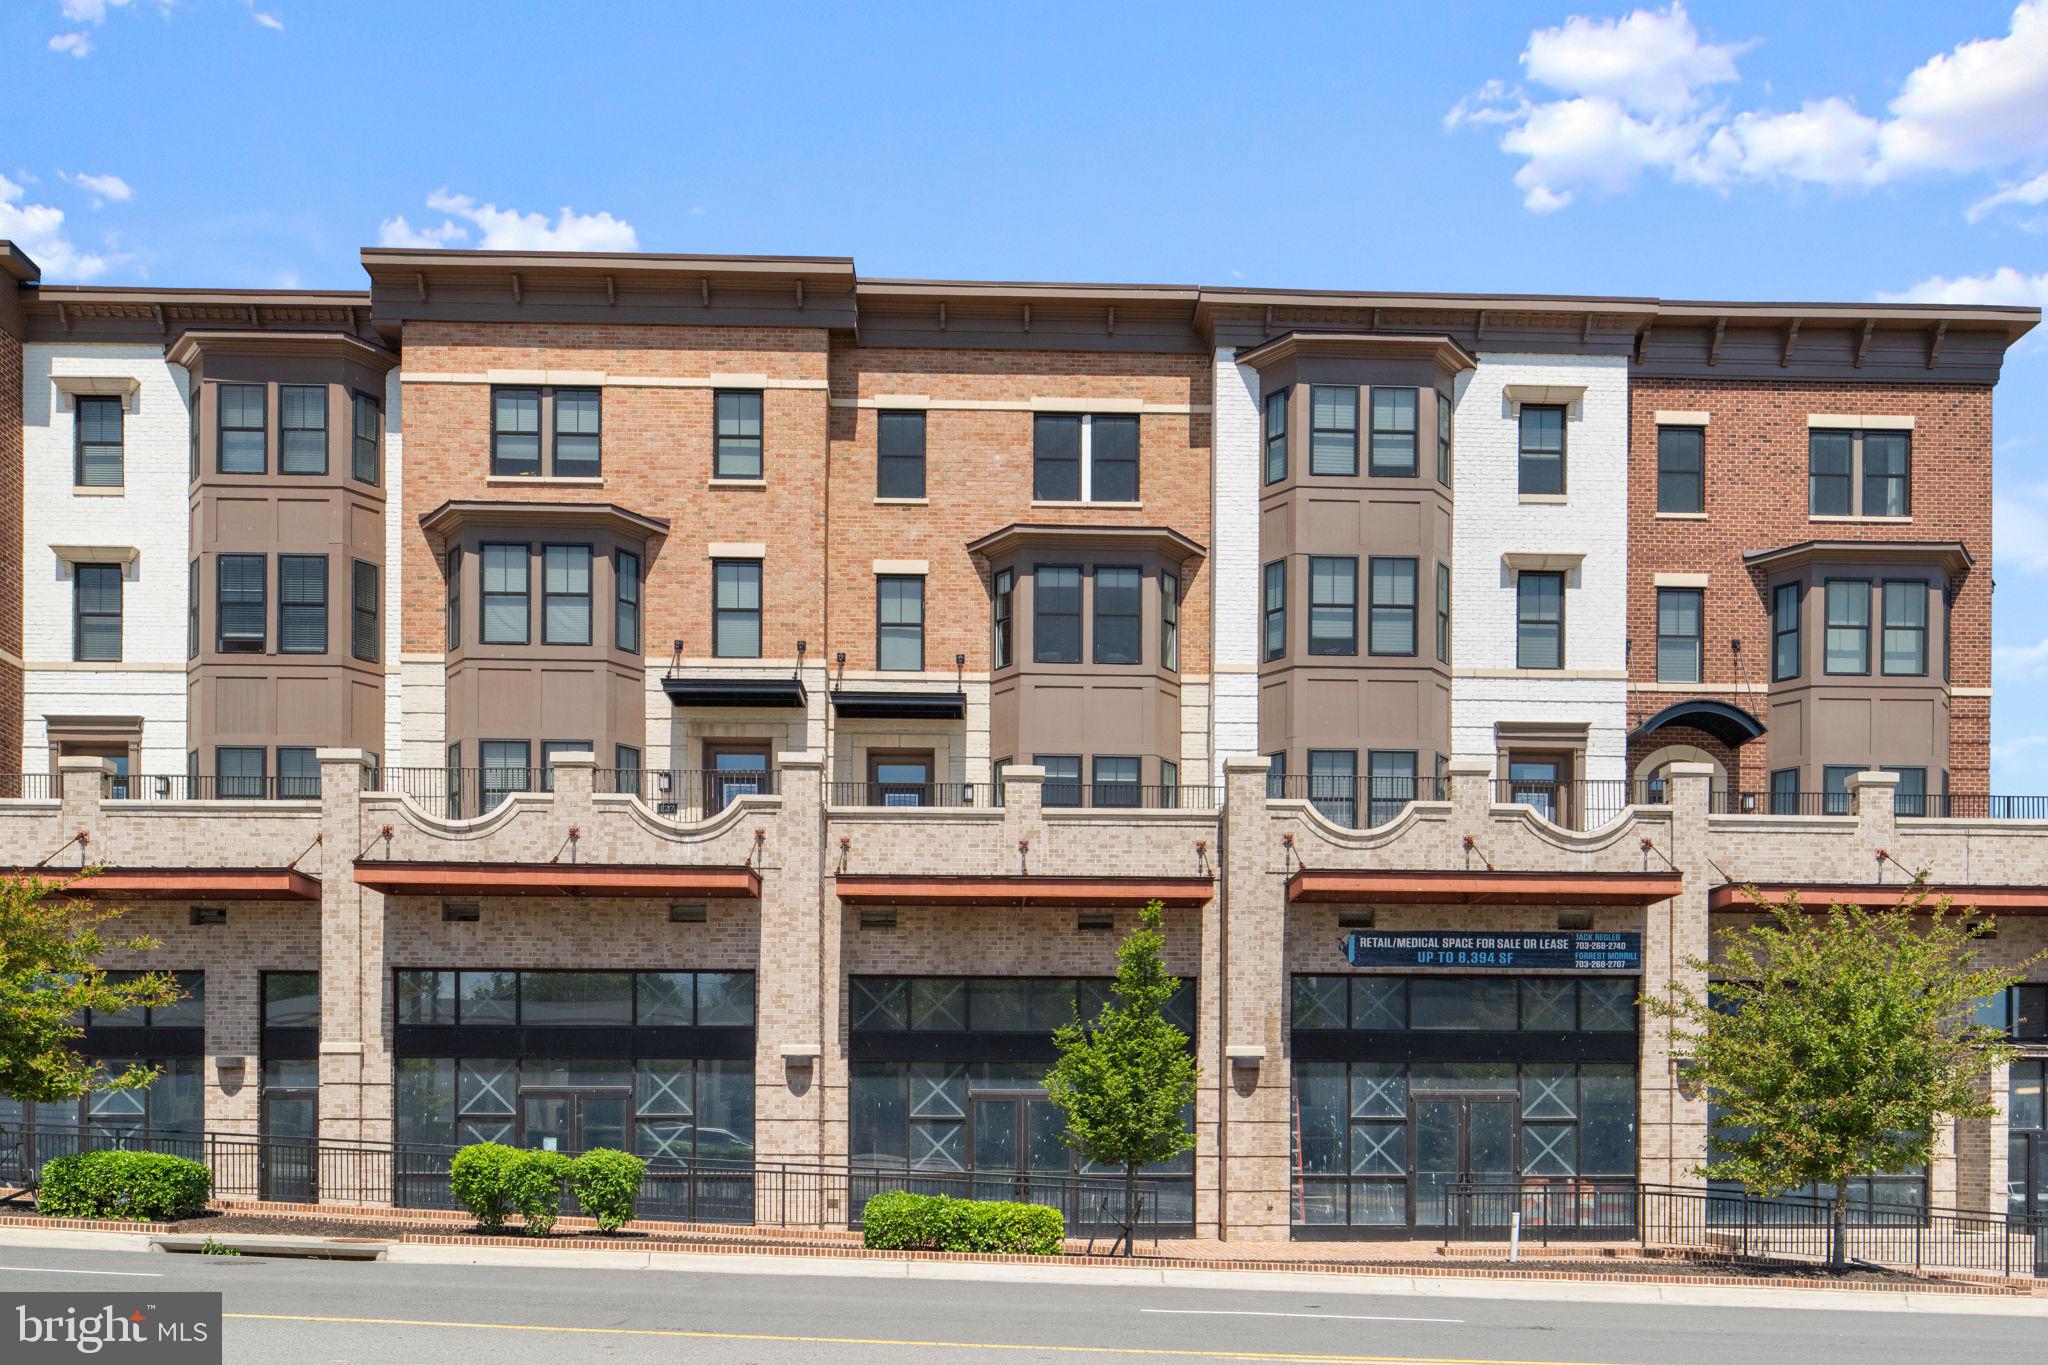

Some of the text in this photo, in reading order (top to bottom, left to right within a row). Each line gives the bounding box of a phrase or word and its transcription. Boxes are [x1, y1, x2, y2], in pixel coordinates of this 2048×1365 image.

[1360, 937, 1569, 950] RETAIL/MEDICAL SPACE FOR SALE OR LEASE
[1575, 942, 1626, 950] 703-268-2740
[1417, 951, 1514, 964] UP TO 8,394 SF
[1575, 952, 1605, 960] FORREST
[1575, 960, 1625, 968] 703-268-2707
